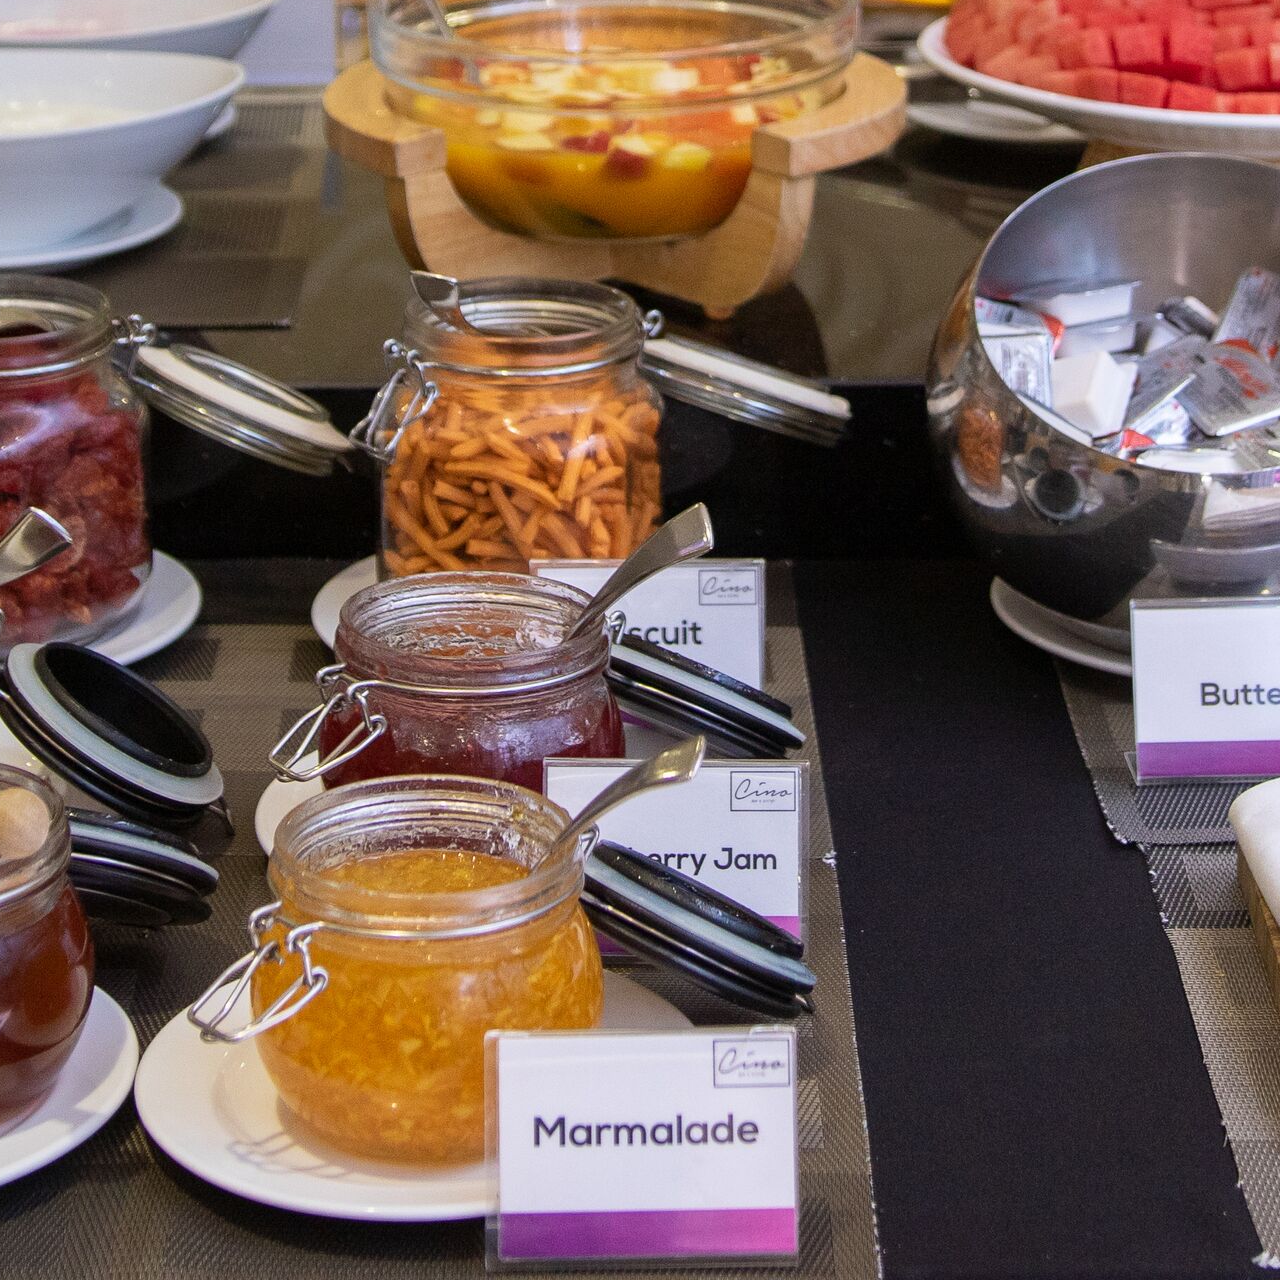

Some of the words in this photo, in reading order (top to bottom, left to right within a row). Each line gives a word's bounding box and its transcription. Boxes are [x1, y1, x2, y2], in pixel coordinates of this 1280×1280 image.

[702, 577, 754, 596] Cino
[626, 620, 702, 645] scuit
[735, 778, 792, 800] Cino
[713, 847, 777, 870] Jam
[533, 1113, 759, 1147] Marmalade
